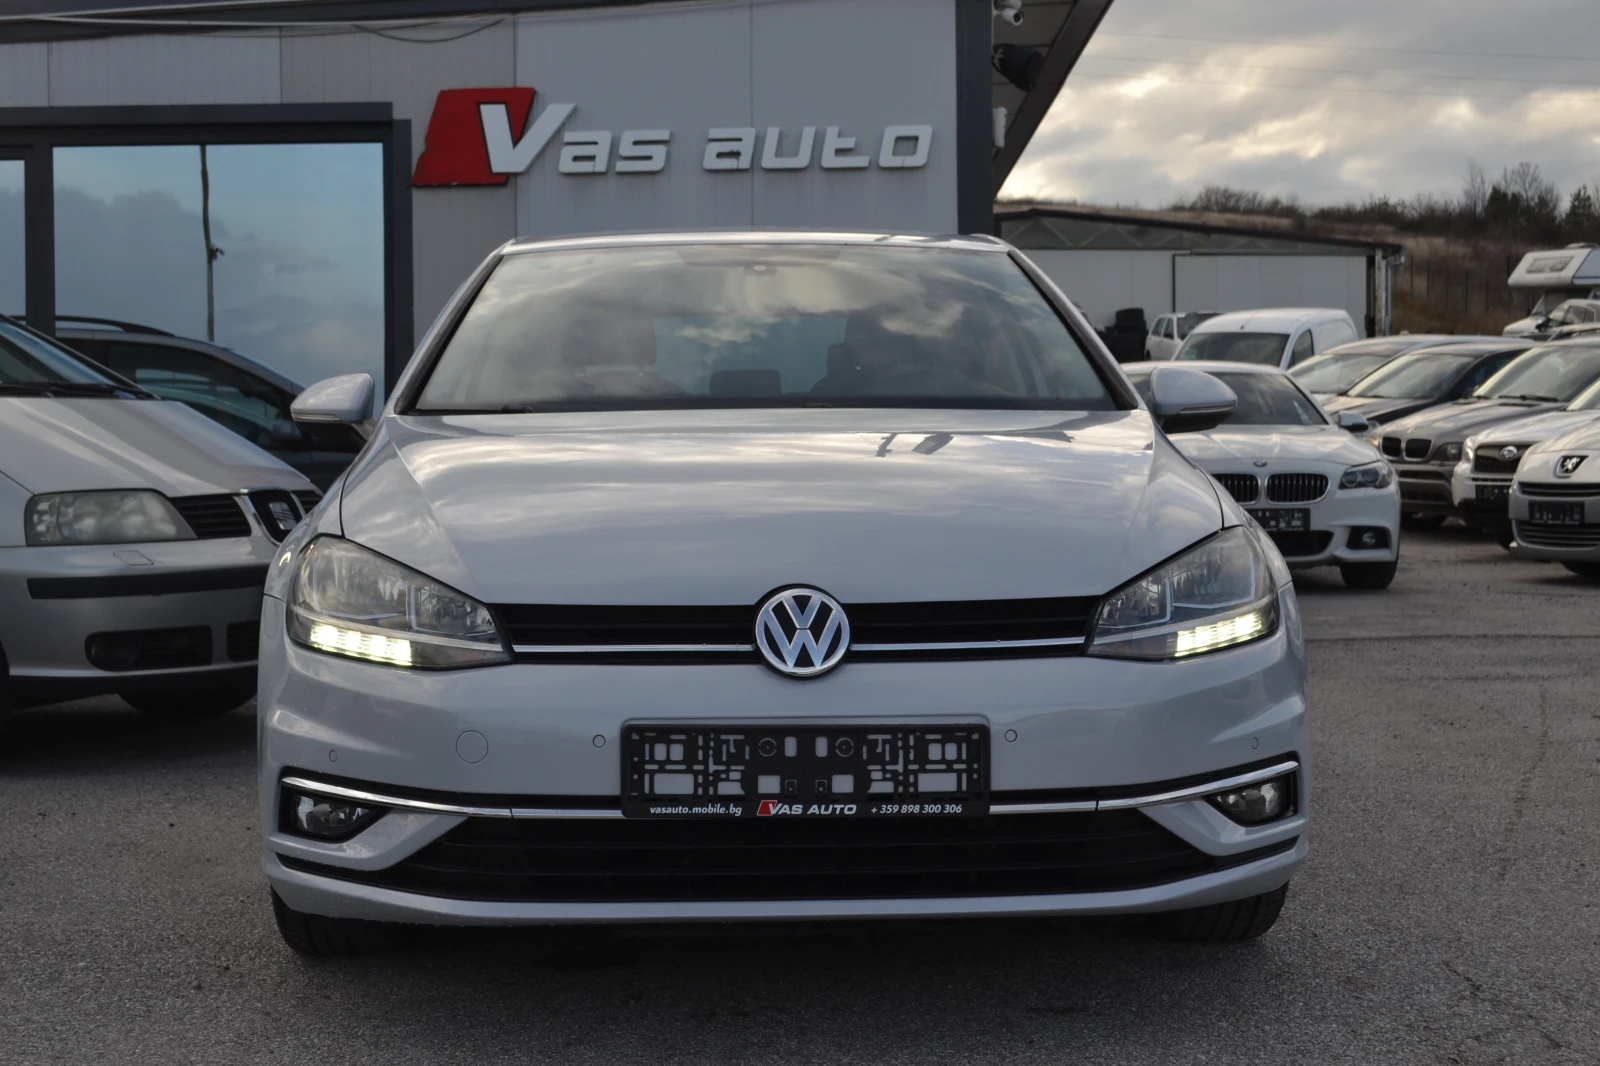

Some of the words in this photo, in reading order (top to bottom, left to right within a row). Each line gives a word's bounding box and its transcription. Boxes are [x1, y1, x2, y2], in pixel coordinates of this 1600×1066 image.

[477, 102, 671, 175] Vas
[702, 124, 933, 171] auto
[649, 803, 742, 816] vasauto.mobile.bg
[768, 803, 803, 815] VAS
[806, 804, 857, 815] AUTO
[879, 804, 899, 814] 359
[900, 804, 920, 814] 898
[922, 804, 941, 814] 300
[943, 804, 962, 814] 306
